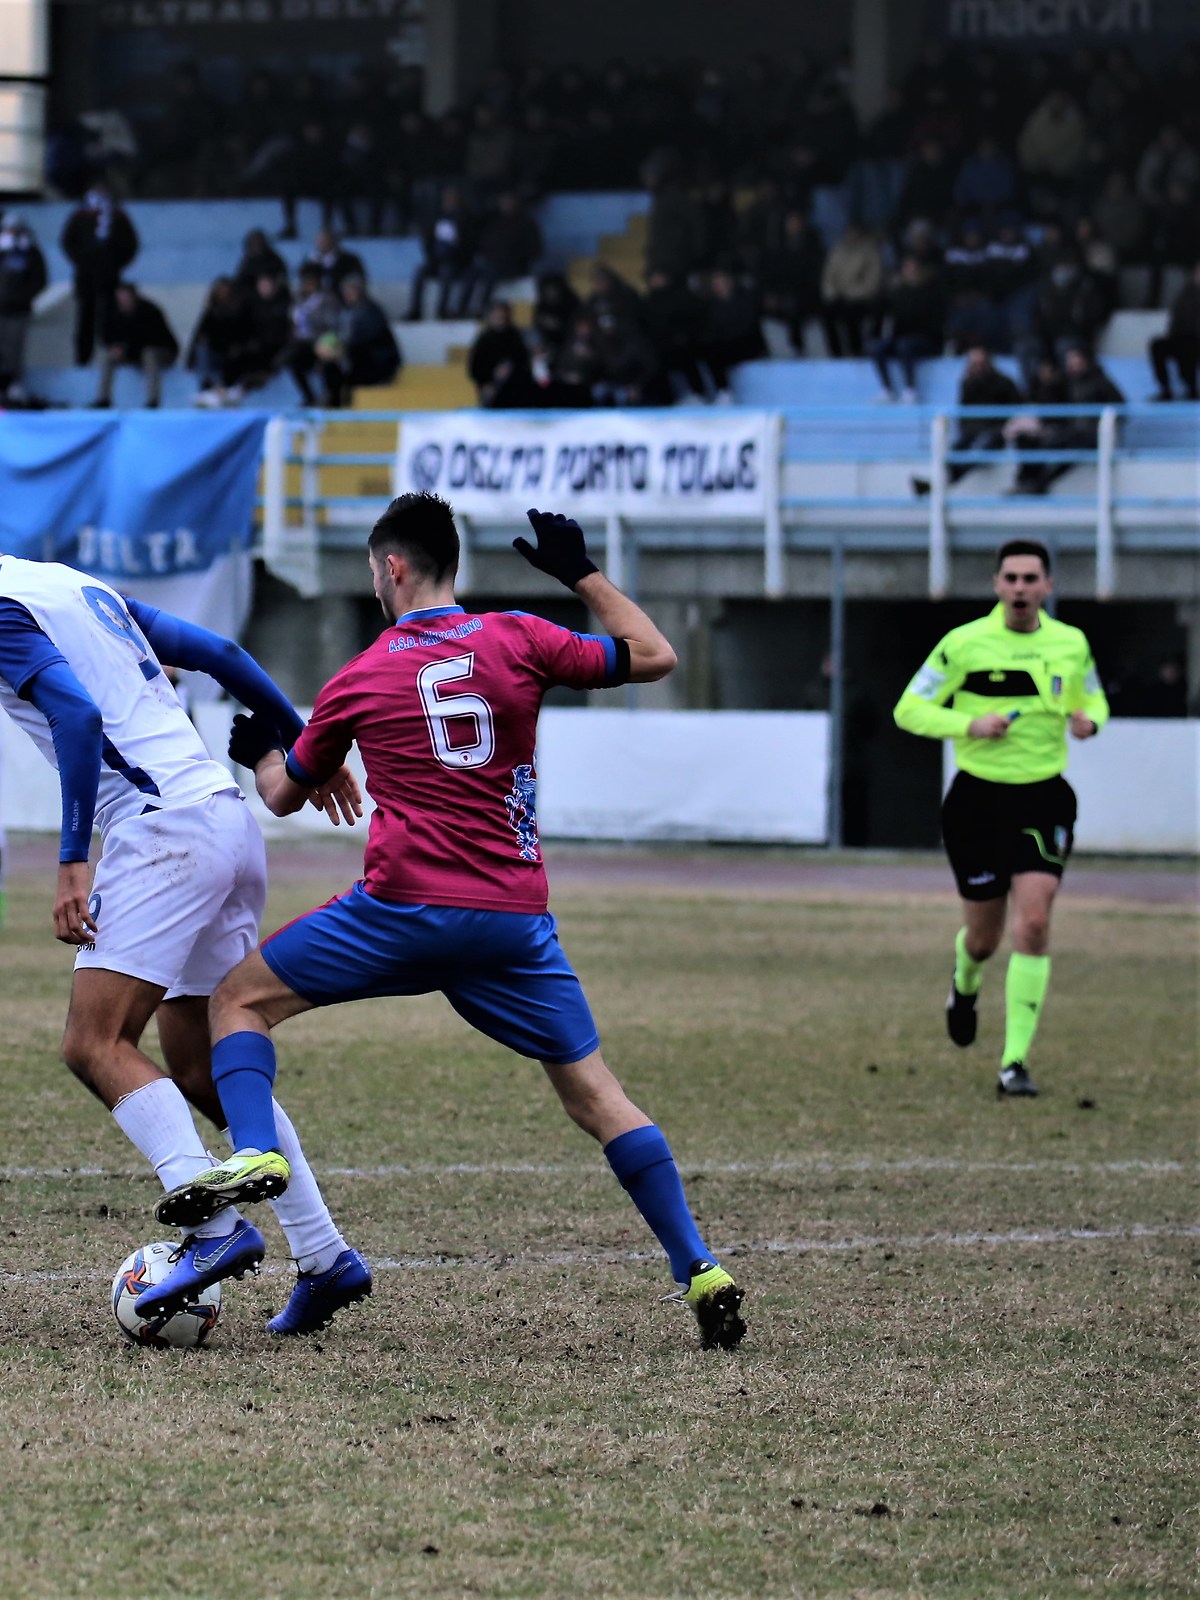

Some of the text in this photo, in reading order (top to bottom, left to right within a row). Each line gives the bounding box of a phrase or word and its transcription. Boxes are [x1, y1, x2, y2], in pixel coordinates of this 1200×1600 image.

[449, 440, 760, 493] DELTA PORTO TOLLE
[415, 651, 496, 771] 6
